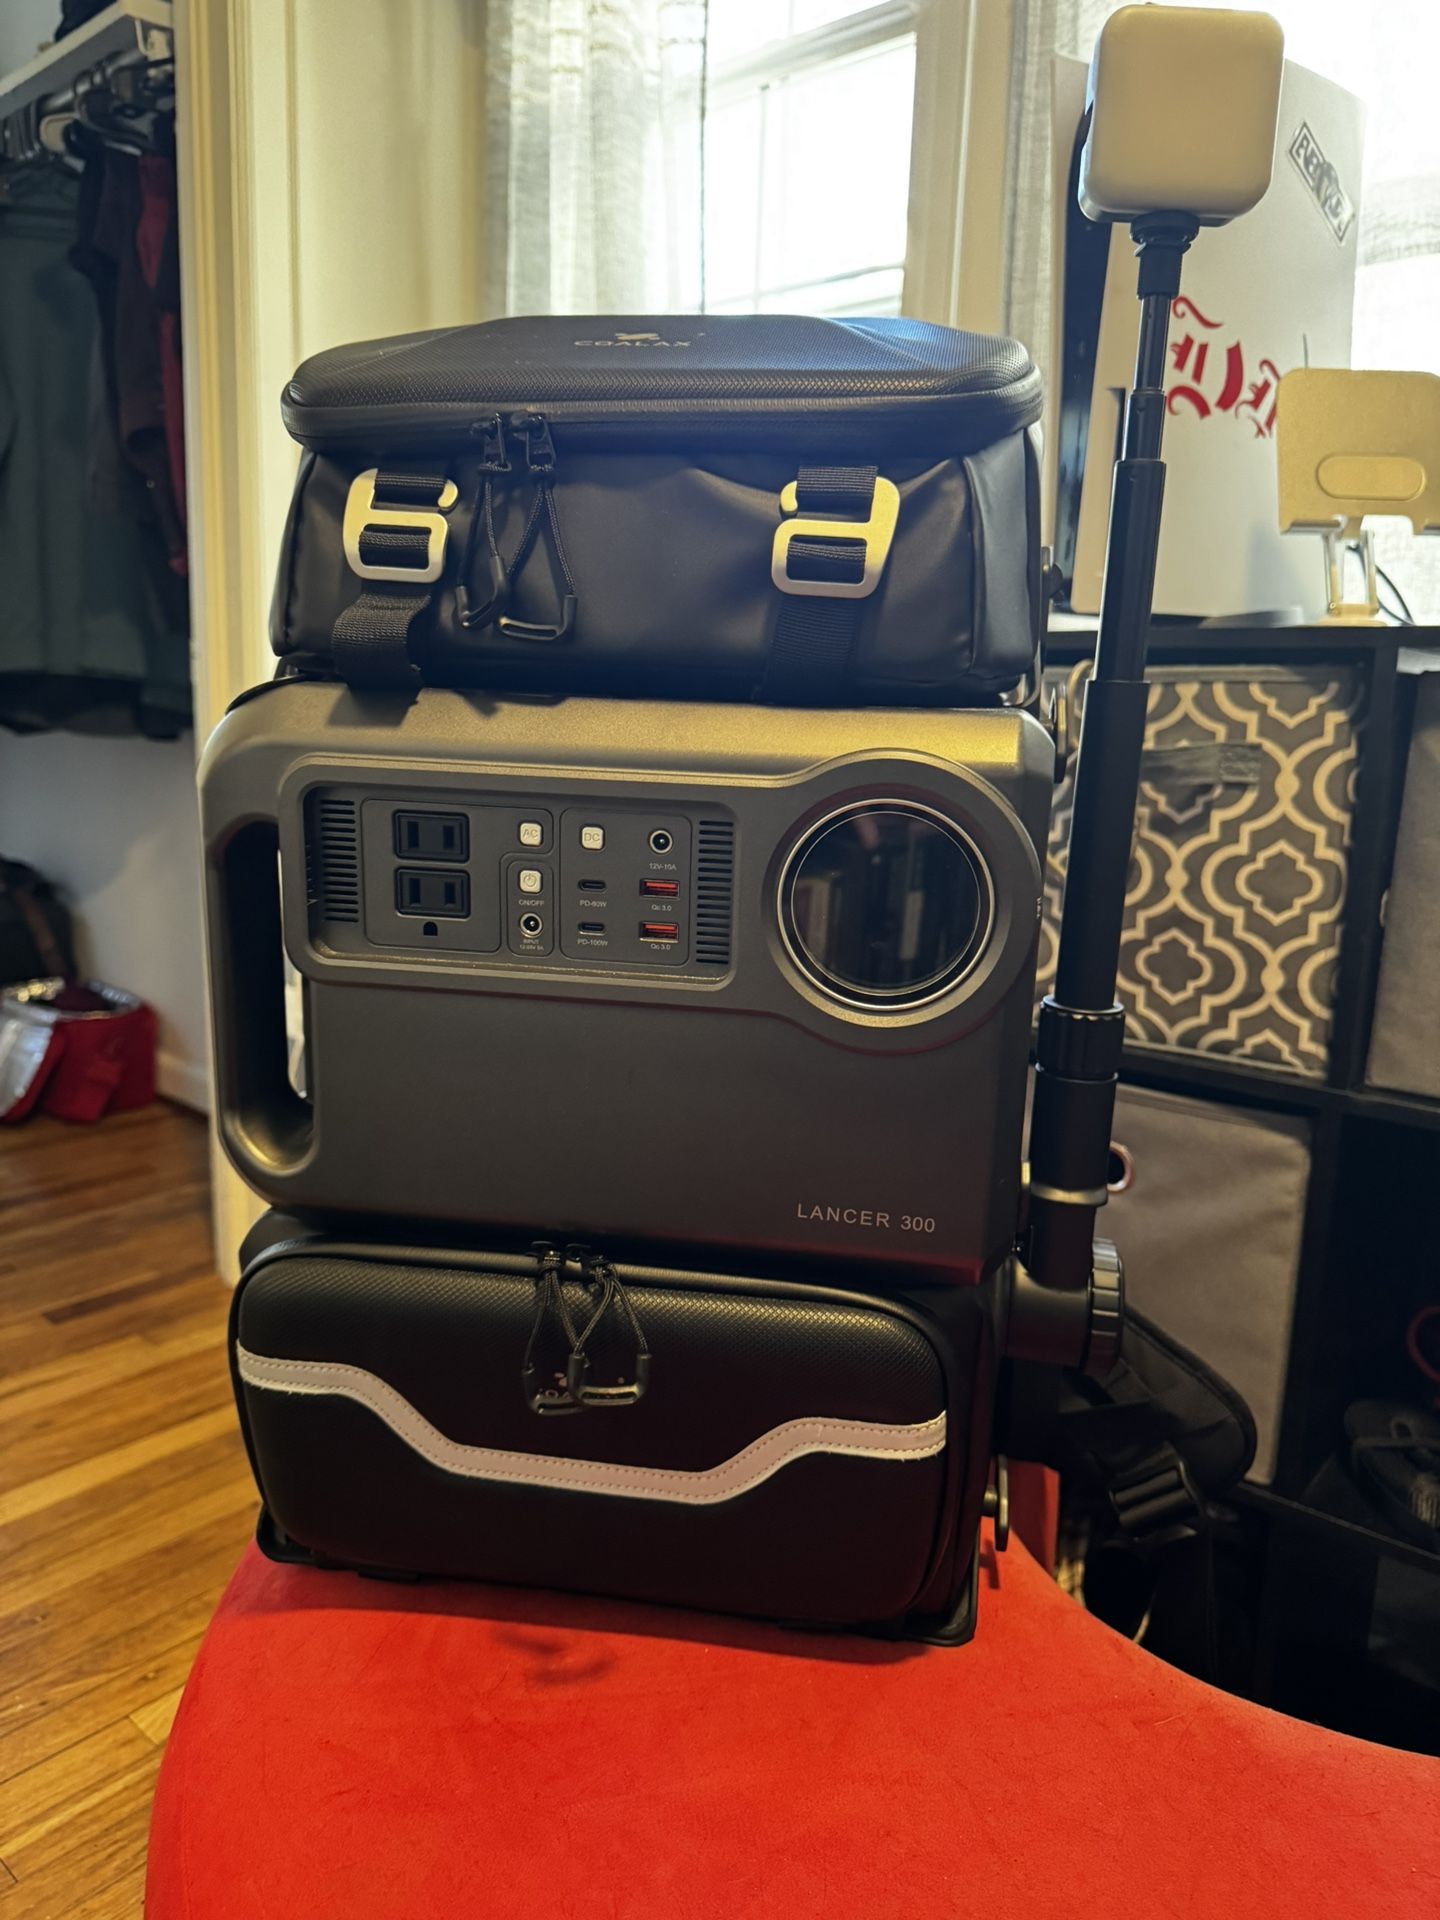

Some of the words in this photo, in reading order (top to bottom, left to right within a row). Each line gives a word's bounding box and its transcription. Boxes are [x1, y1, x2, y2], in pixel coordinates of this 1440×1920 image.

[522, 828, 539, 838] AC
[583, 832, 601, 842] DC
[518, 899, 545, 907] ON/OFF
[797, 1203, 890, 1228] LANCER
[900, 1215, 936, 1233] 300
